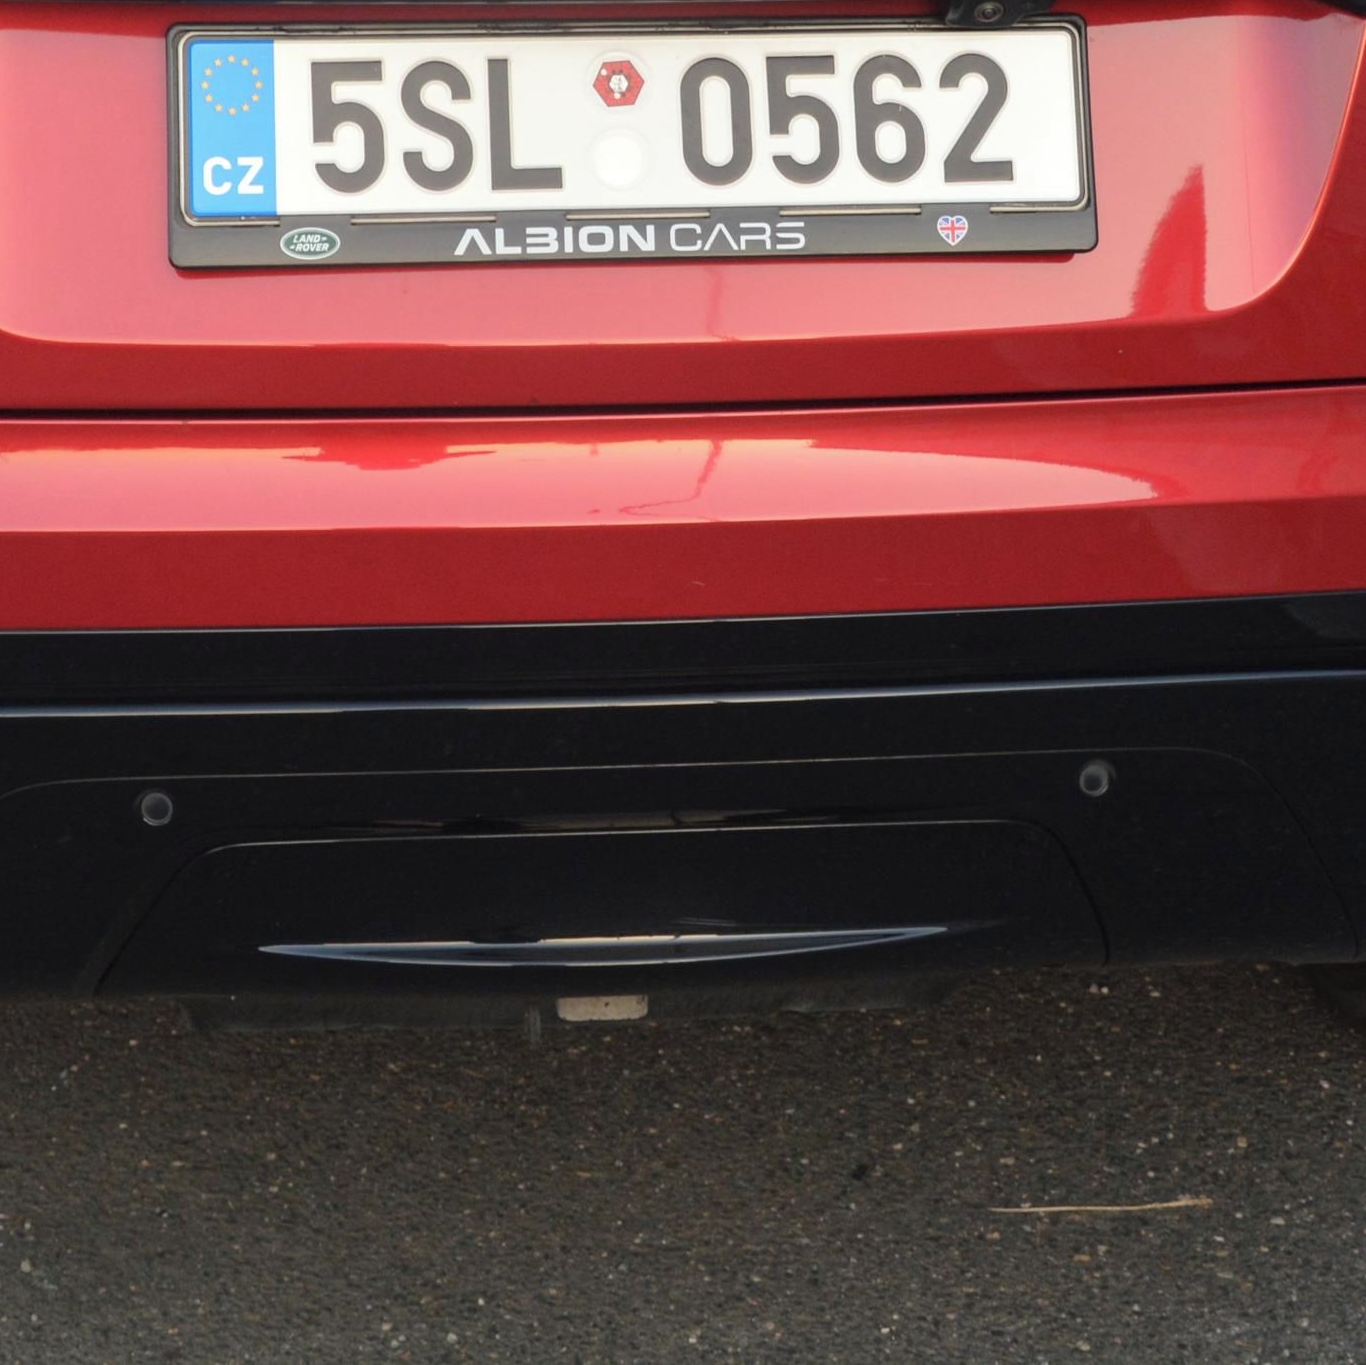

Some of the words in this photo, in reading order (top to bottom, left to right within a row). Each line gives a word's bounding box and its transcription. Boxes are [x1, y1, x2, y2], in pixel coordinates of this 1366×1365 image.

[308, 56, 565, 194] 5SL
[679, 52, 1016, 188] 0562
[202, 155, 265, 196] CZ
[453, 224, 656, 256] ALBION
[668, 221, 807, 253] CARS
